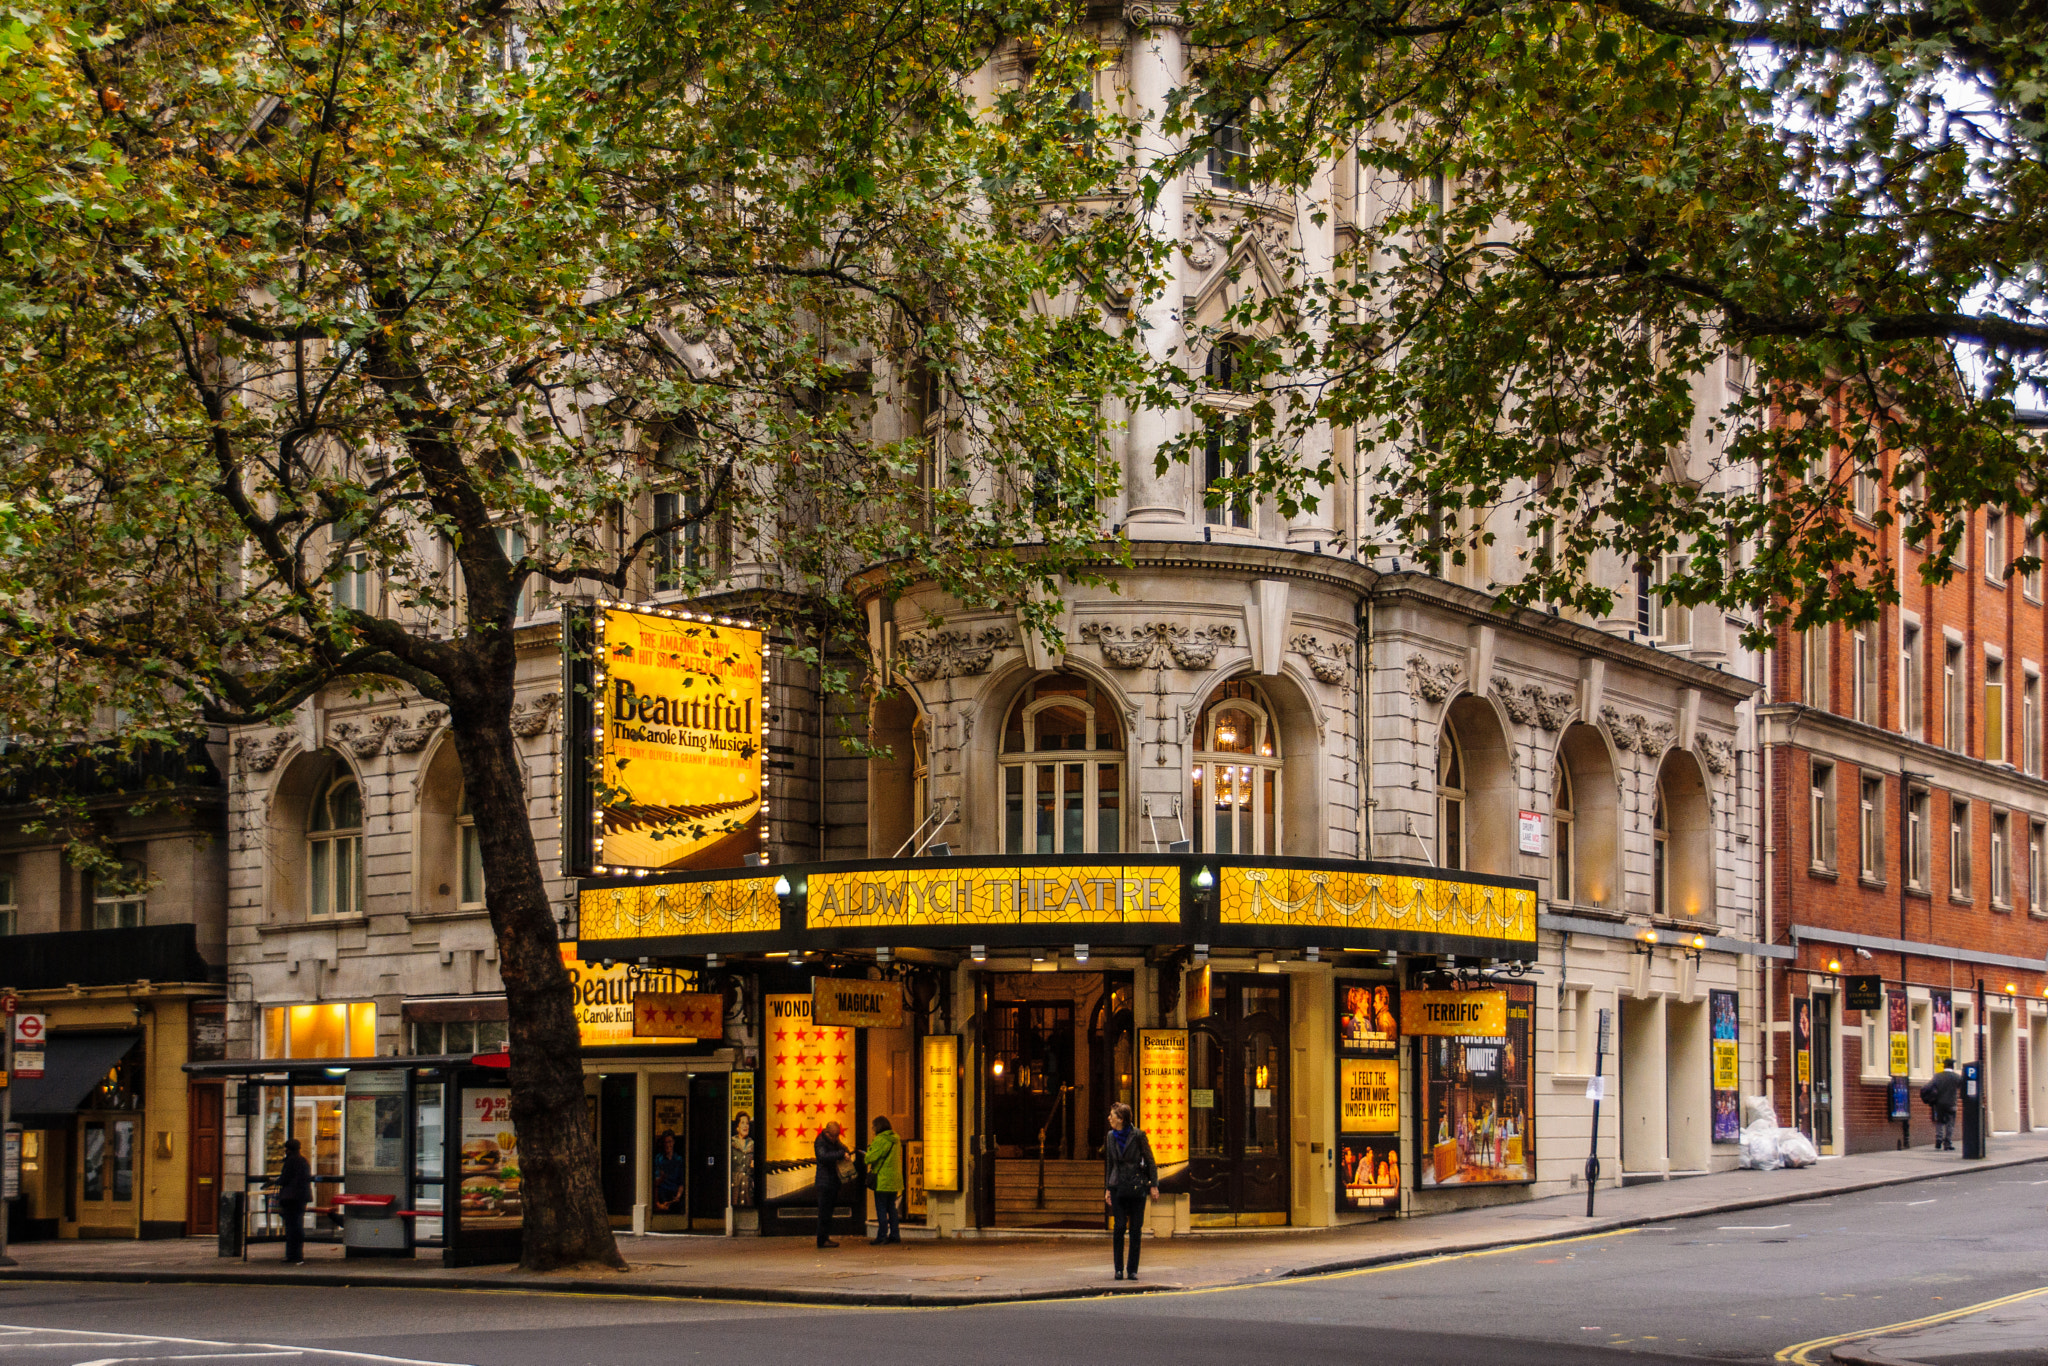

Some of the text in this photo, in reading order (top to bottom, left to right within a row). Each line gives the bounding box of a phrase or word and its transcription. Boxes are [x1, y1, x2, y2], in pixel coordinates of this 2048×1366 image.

[640, 631, 730, 658] THE AMAZING STORY
[639, 650, 653, 666] HIT
[657, 651, 681, 670] SONG
[683, 655, 711, 674] AFTER
[714, 660, 728, 676] HIT
[731, 662, 754, 679] SONG
[614, 677, 752, 734] Beautiful
[614, 721, 752, 752] The Carole King Musical
[615, 745, 626, 756] THE
[649, 750, 672, 762] OLIVIER
[681, 753, 707, 765] GRAMMY
[818, 878, 1165, 916] ALDWYCH THEATRE
[7, 998, 15, 1012] E
[769, 1000, 813, 1017] 'WOND
[835, 993, 884, 1013] 'MAGICAL'
[584, 1008, 614, 1023] Carole
[616, 1007, 633, 1022] Kin
[1423, 1004, 1483, 1021] 'TERRIFIC'
[1144, 1036, 1185, 1046] Beautiful
[1359, 1072, 1372, 1086] FELT
[1374, 1072, 1386, 1086] THE
[1968, 1068, 1976, 1078] P
[1350, 1087, 1390, 1101] EARTH MOVE
[475, 1096, 506, 1122] £2.99
[1345, 1103, 1396, 1117] UNDER MY FEET'
